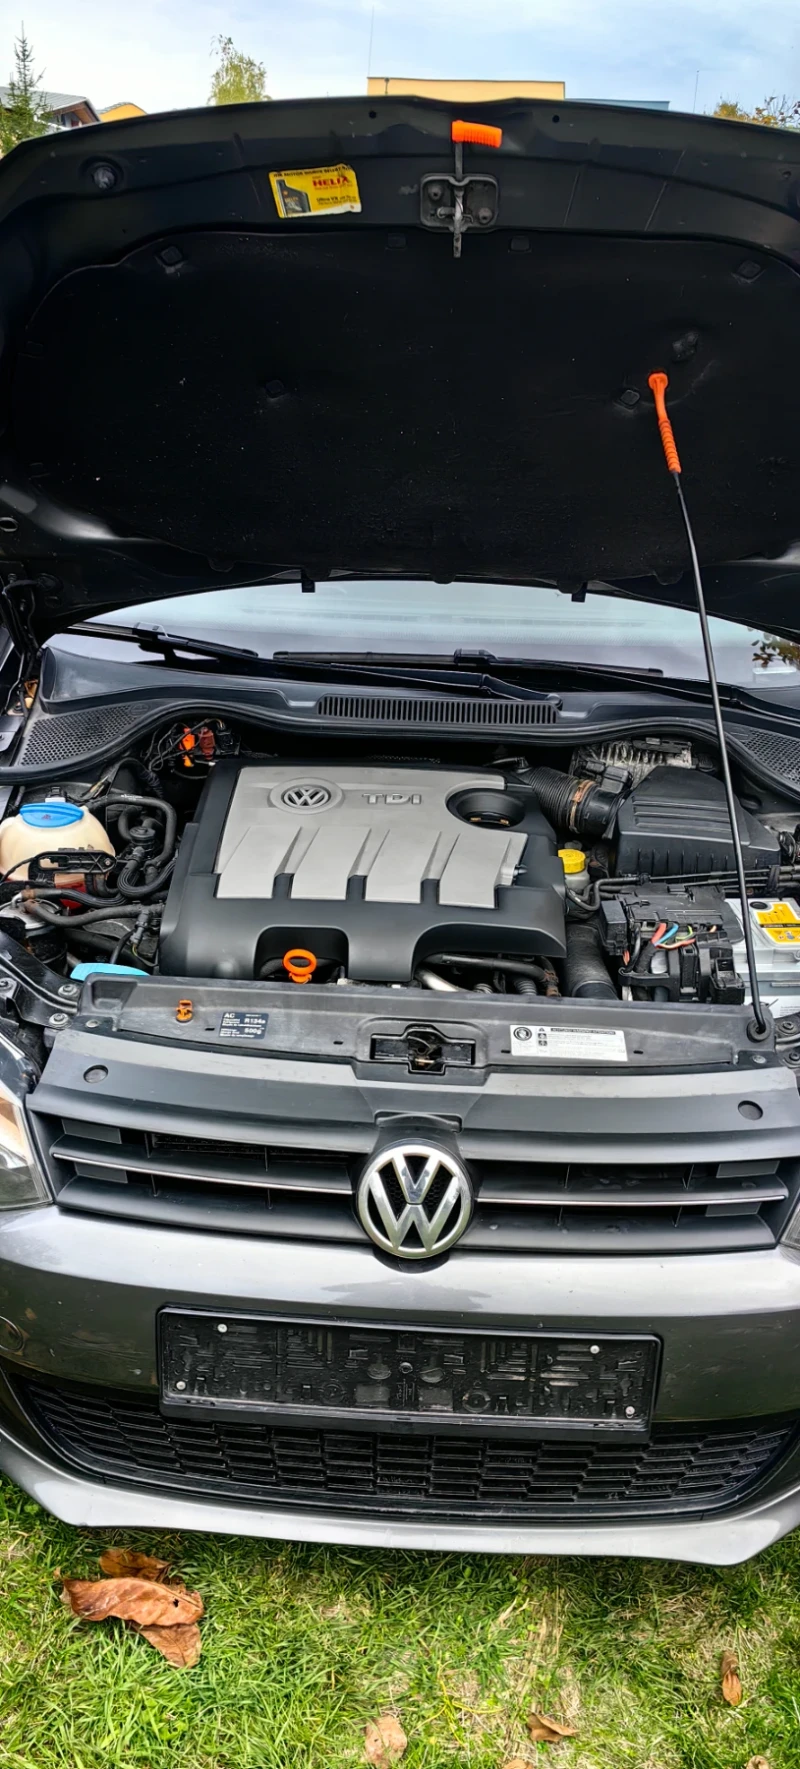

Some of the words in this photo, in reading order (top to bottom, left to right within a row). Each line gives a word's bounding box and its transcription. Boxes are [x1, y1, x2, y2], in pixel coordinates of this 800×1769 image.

[313, 176, 349, 187] HELIX
[362, 793, 422, 805] TDI
[362, 1147, 467, 1255] VW
